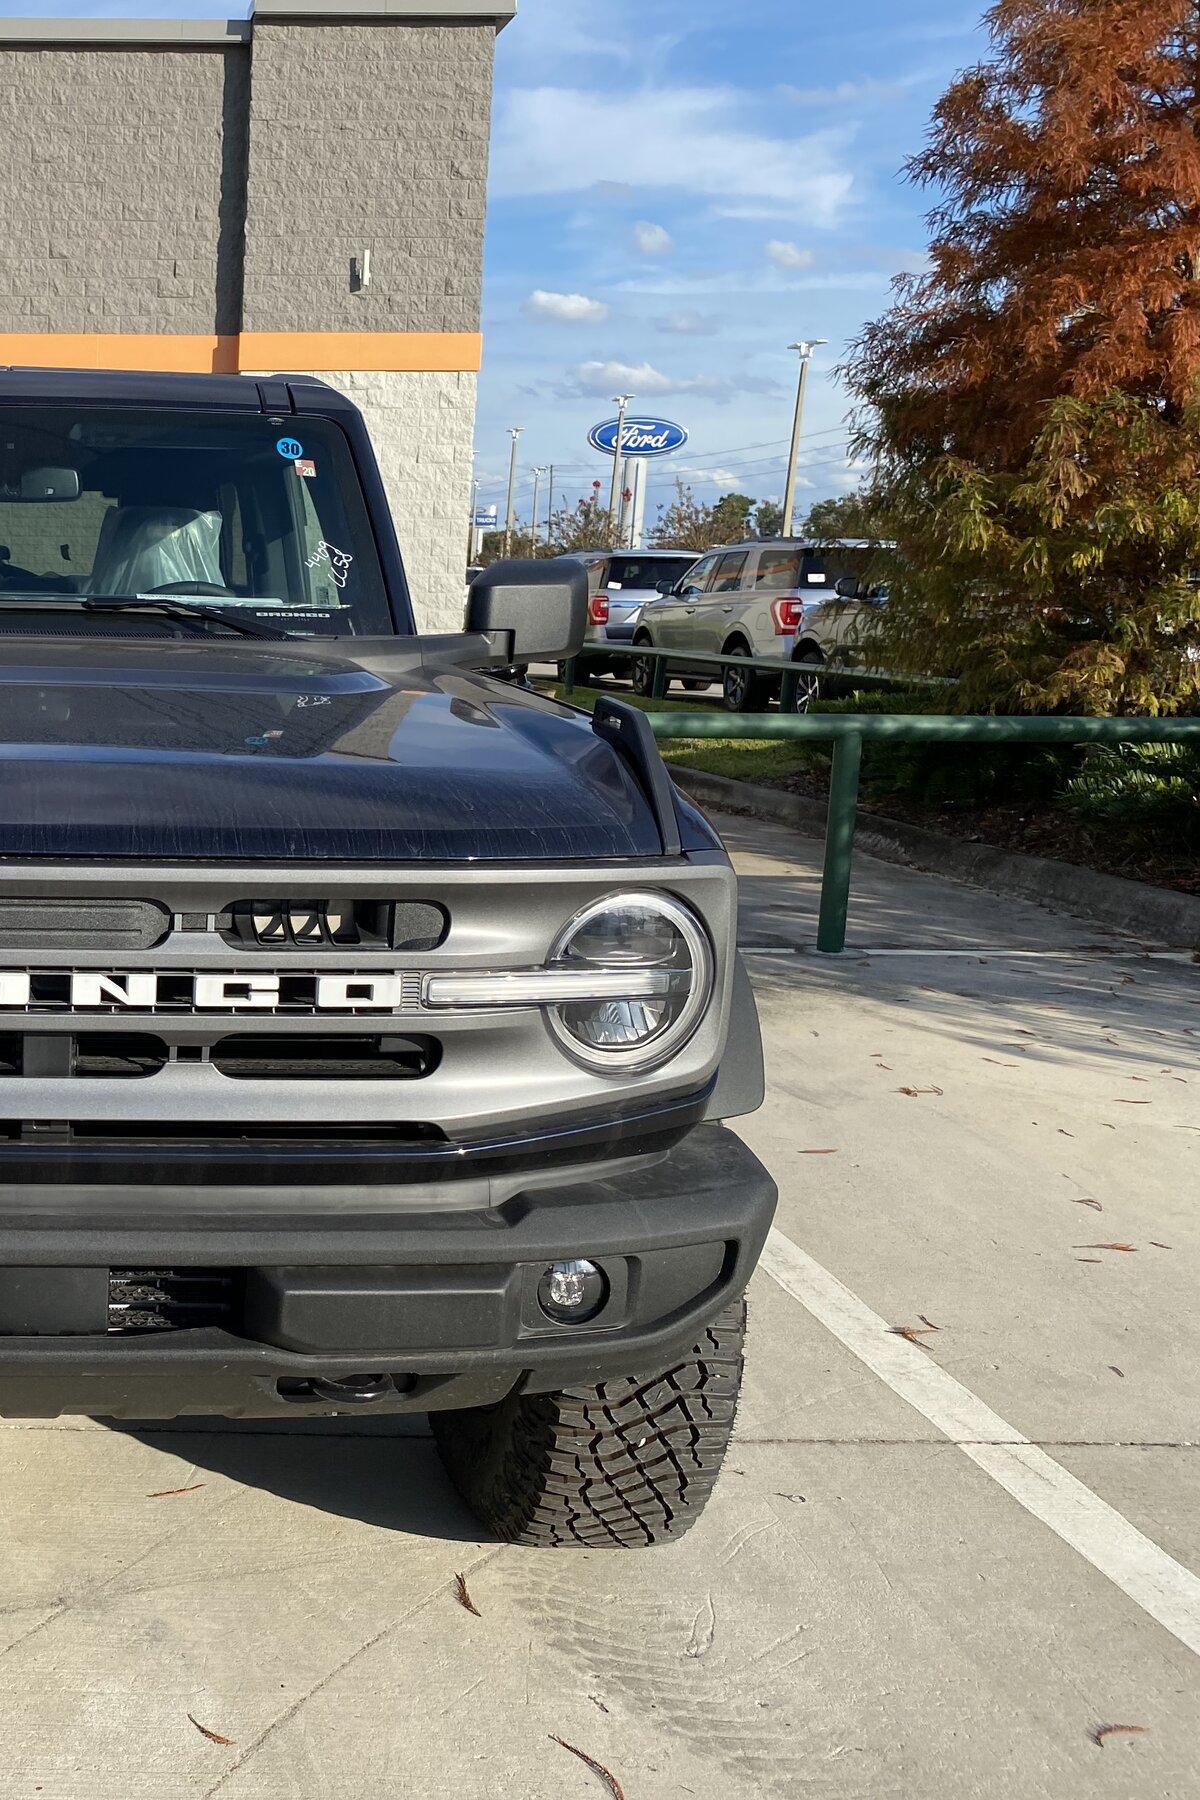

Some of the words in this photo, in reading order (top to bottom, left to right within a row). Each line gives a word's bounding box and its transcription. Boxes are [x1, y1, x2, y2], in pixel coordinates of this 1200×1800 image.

[611, 423, 670, 448] Ford
[281, 441, 300, 456] 30
[302, 466, 314, 476] 20
